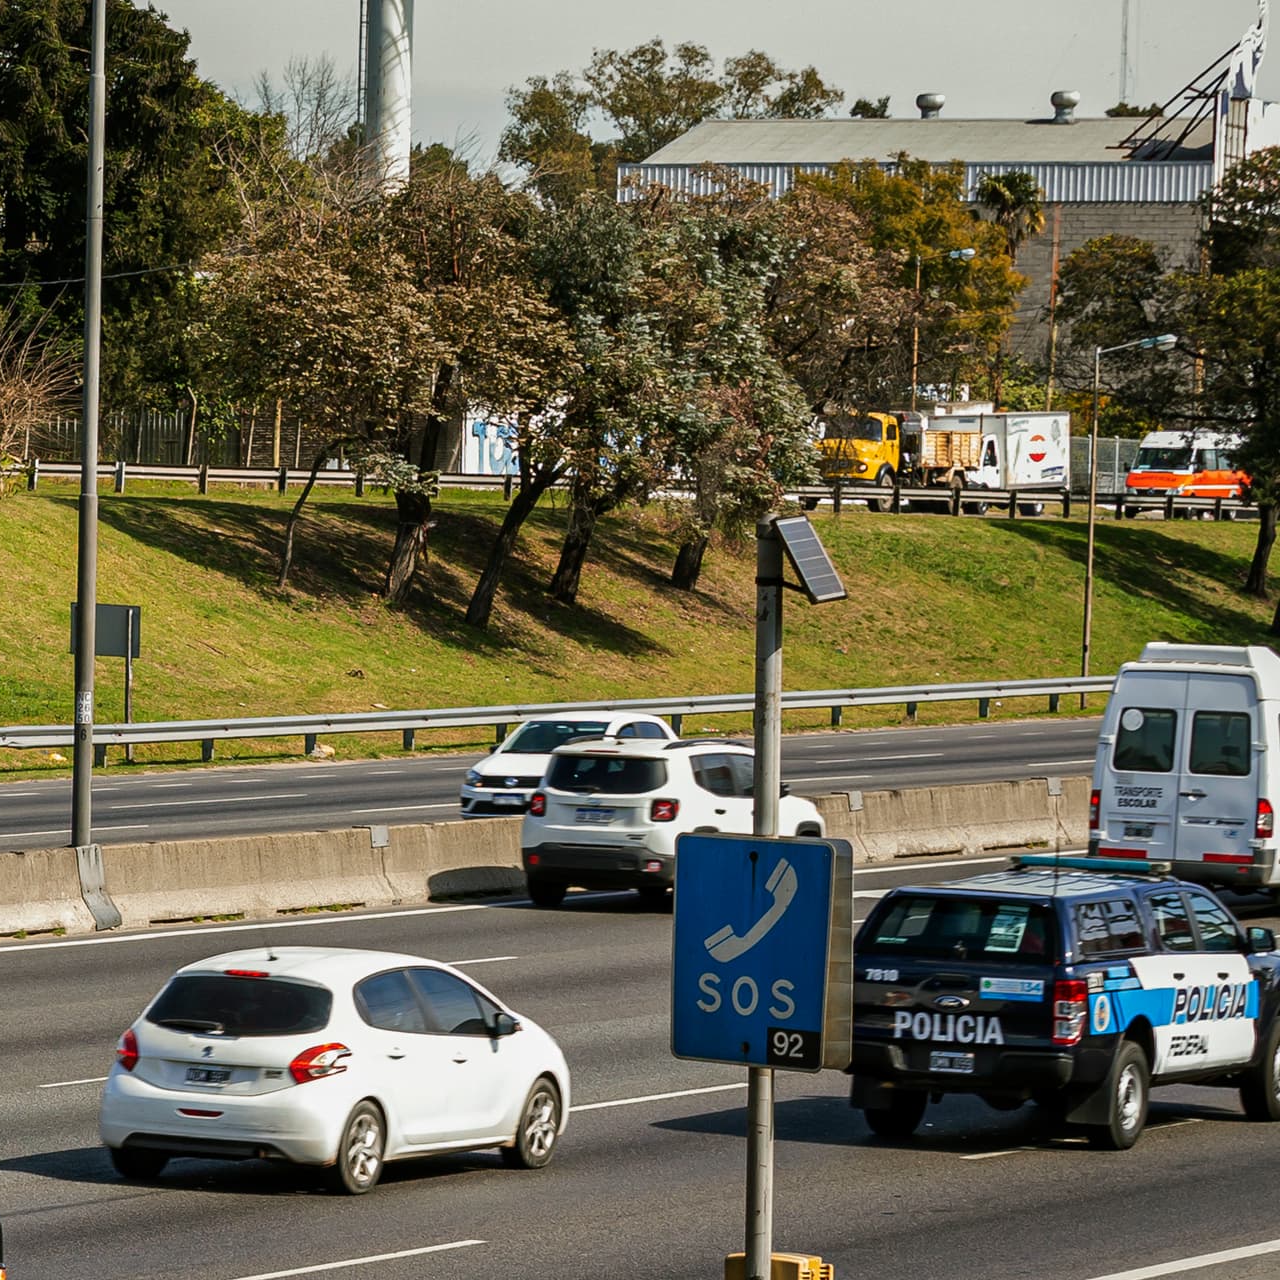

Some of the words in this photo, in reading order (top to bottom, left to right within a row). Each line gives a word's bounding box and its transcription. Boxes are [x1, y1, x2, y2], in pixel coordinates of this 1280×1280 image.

[1114, 786, 1163, 798] TRANSPORTE
[1118, 798, 1157, 809] ESCOLAR
[696, 972, 796, 1020] SOS
[1170, 983, 1247, 1024] POLICIA
[893, 1010, 1005, 1045] POLICIA
[772, 1031, 804, 1058] 92
